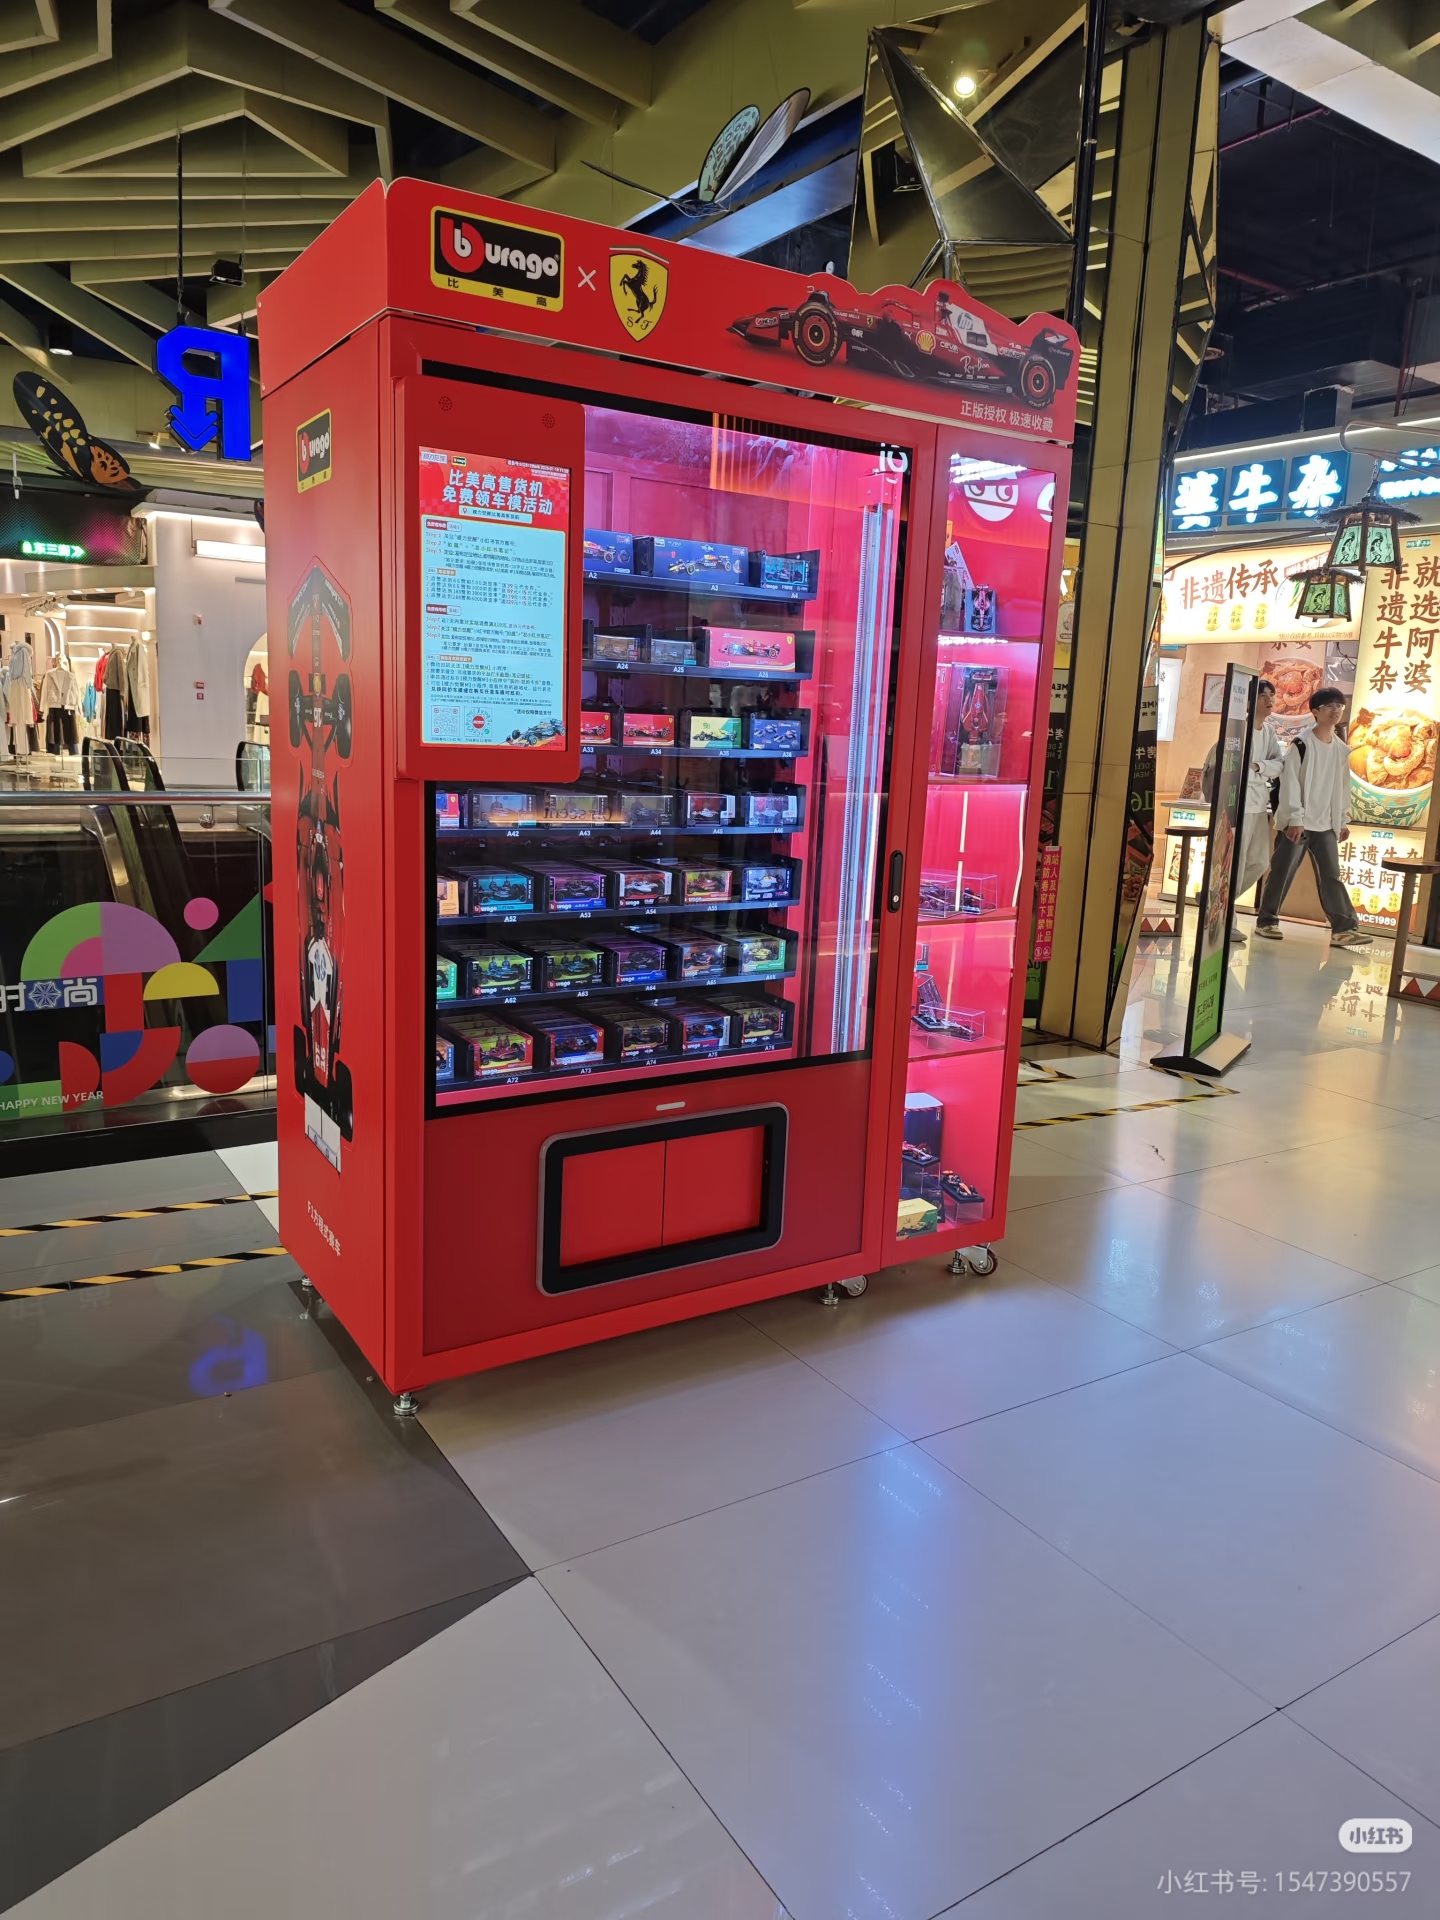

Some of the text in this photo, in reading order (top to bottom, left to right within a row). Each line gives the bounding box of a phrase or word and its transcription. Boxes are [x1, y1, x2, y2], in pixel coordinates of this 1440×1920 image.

[959, 355, 990, 374] Ray-Ban
[960, 400, 1053, 433] 正版授权 极速收藏
[442, 485, 553, 516] 免费领车模活动
[448, 468, 544, 498] 比美高售货机
[1172, 454, 1342, 530] 婆牛杂
[1180, 558, 1279, 610] 非遗传承
[1369, 558, 1410, 694] 非遗牛杂
[1404, 556, 1440, 694] 就选阿婆
[1036, 854, 1051, 943] 消防卷帘下禁止
[1044, 853, 1060, 942] 站人及放置物品
[1356, 912, 1397, 927] NCE1989
[0, 1090, 104, 1111] HAPPY NEW YEAR
